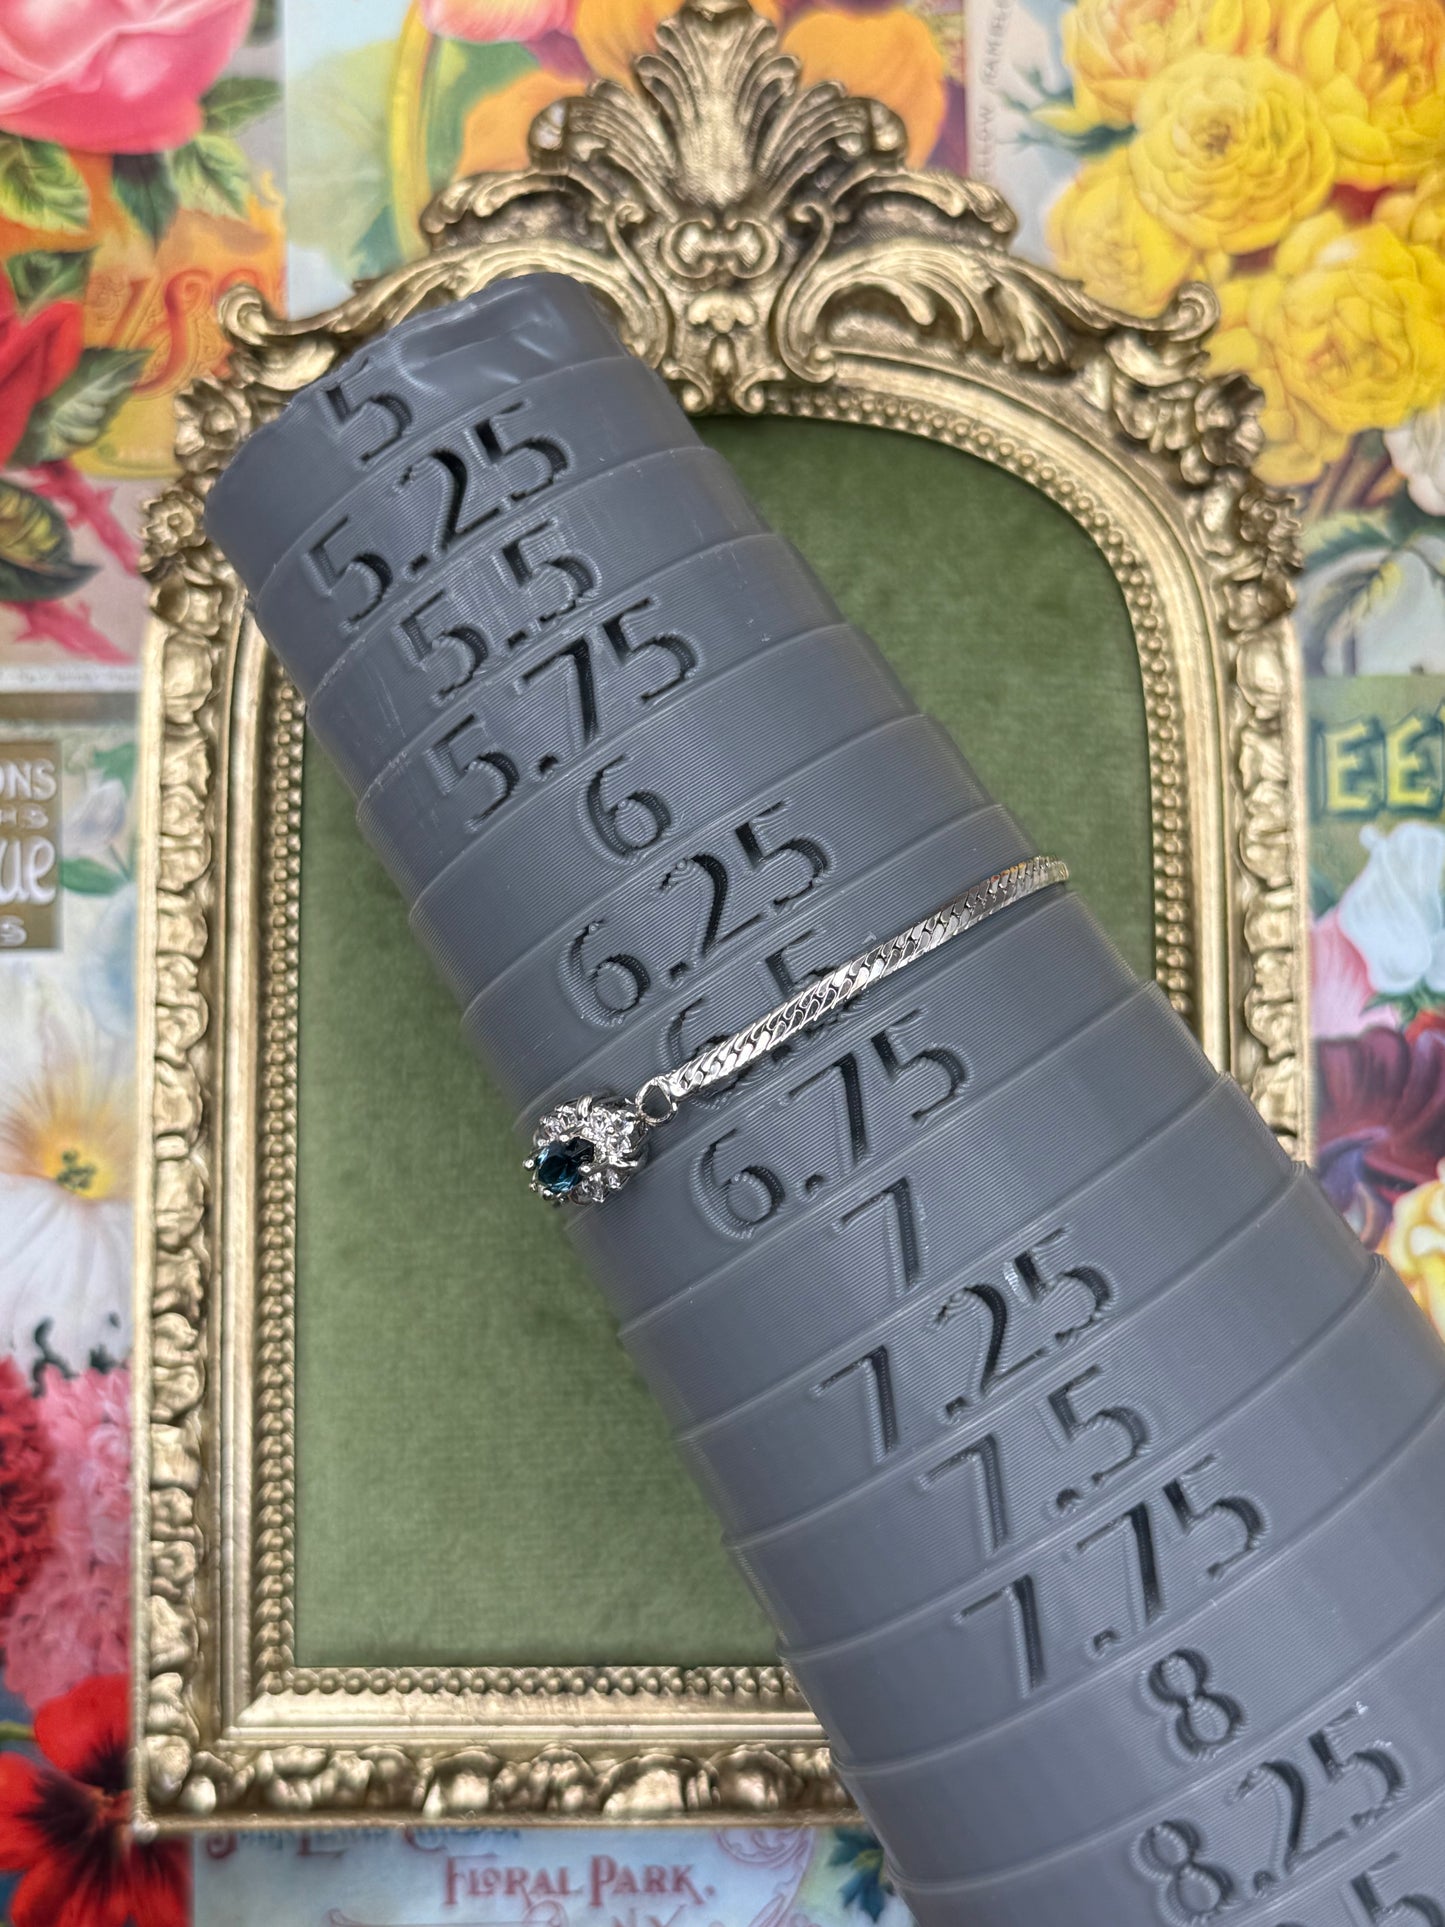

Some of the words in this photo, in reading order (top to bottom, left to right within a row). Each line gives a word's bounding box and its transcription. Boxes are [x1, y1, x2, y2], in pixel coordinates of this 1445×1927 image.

[304, 401, 573, 631] 5.25
[320, 359, 413, 469] 5
[397, 517, 602, 704] 5.5
[425, 597, 699, 830] 5.75
[583, 755, 671, 864] 6
[562, 801, 834, 1028] 6.25
[692, 1009, 971, 1238] 6.75
[833, 1177, 926, 1296] 7
[811, 1225, 1117, 1463] 7.25
[917, 1365, 1154, 1558] 7.5
[954, 1453, 1268, 1697] 7.75
[1142, 1648, 1246, 1762] 8
[443, 1851, 582, 1908] FLORAL
[1131, 1702, 1403, 1927] 8.25
